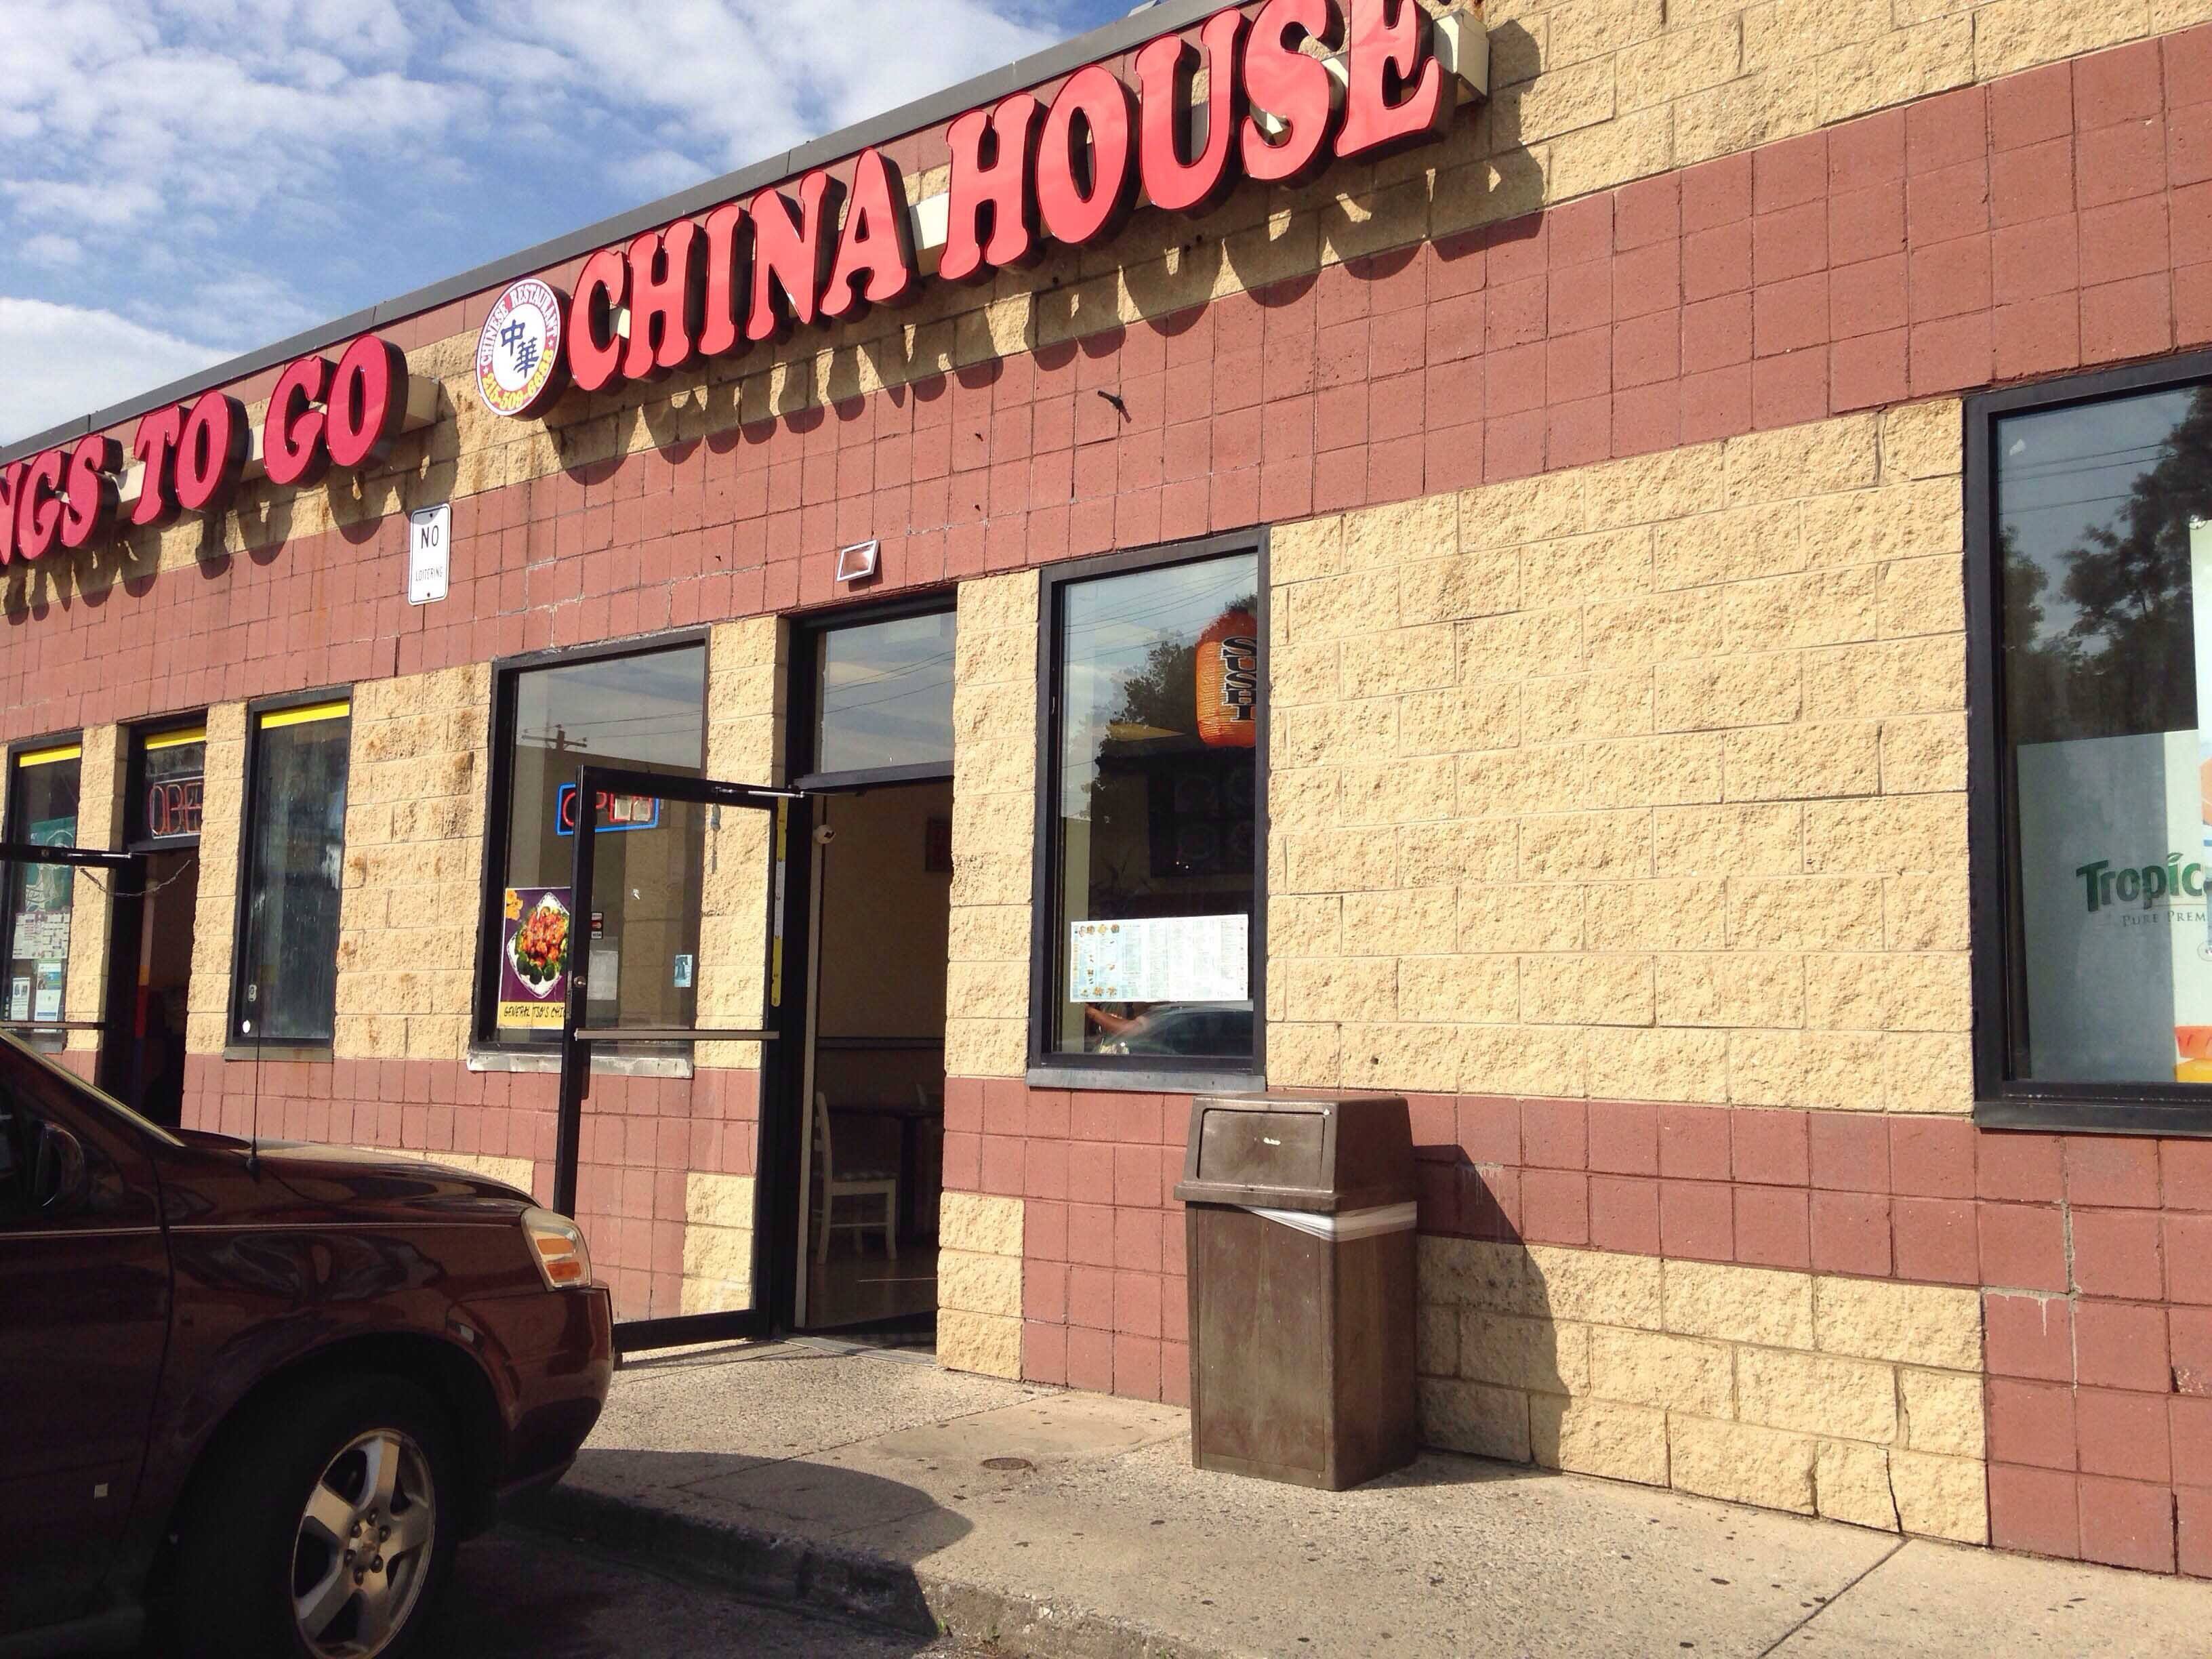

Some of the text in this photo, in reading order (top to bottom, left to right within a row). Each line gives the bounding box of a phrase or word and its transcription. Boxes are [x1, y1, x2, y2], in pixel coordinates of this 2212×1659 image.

[567, 0, 1446, 391] CHINA HOUSE
[480, 283, 558, 367] CHINESE RESTAURANT
[132, 390, 237, 525] TO
[262, 334, 394, 487] GO
[421, 525, 440, 550] NO
[415, 566, 443, 581] LOITERING
[2076, 852, 2209, 912] Tropic
[2167, 910, 2207, 922] PREM
